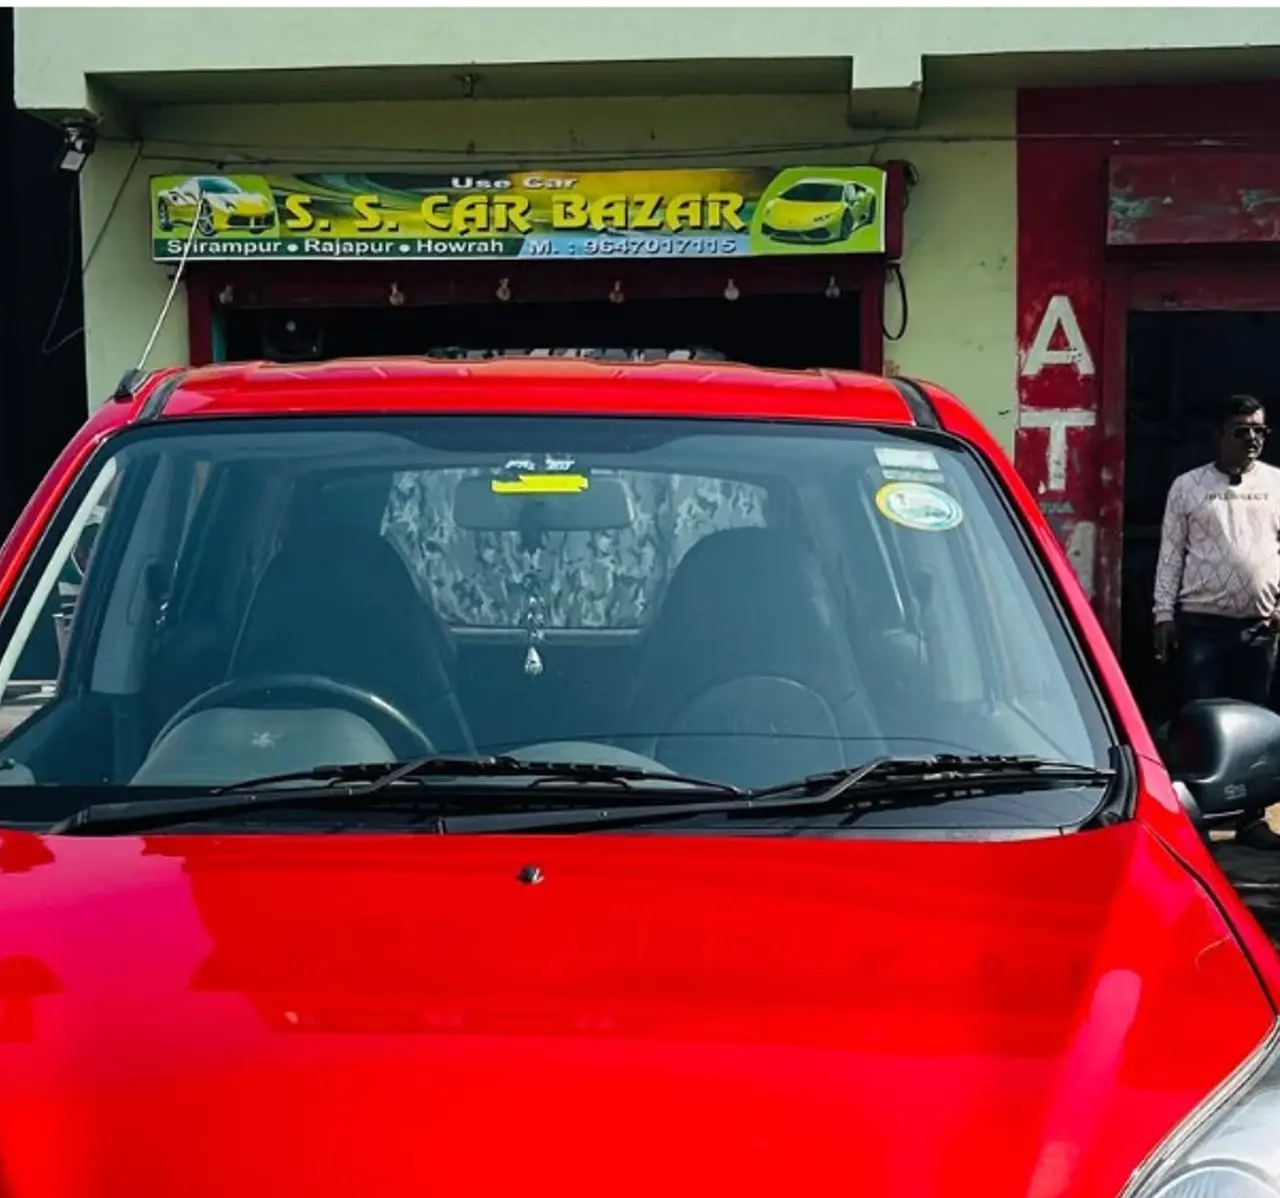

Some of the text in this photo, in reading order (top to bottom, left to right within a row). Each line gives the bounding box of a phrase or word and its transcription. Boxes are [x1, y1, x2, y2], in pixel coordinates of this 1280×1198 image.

[450, 176, 577, 190] Use Car
[284, 192, 747, 234] S. S. CAR BAZAR
[304, 239, 394, 257] Rajapur
[416, 239, 504, 253] Howrah
[584, 239, 738, 254] 9647017115
